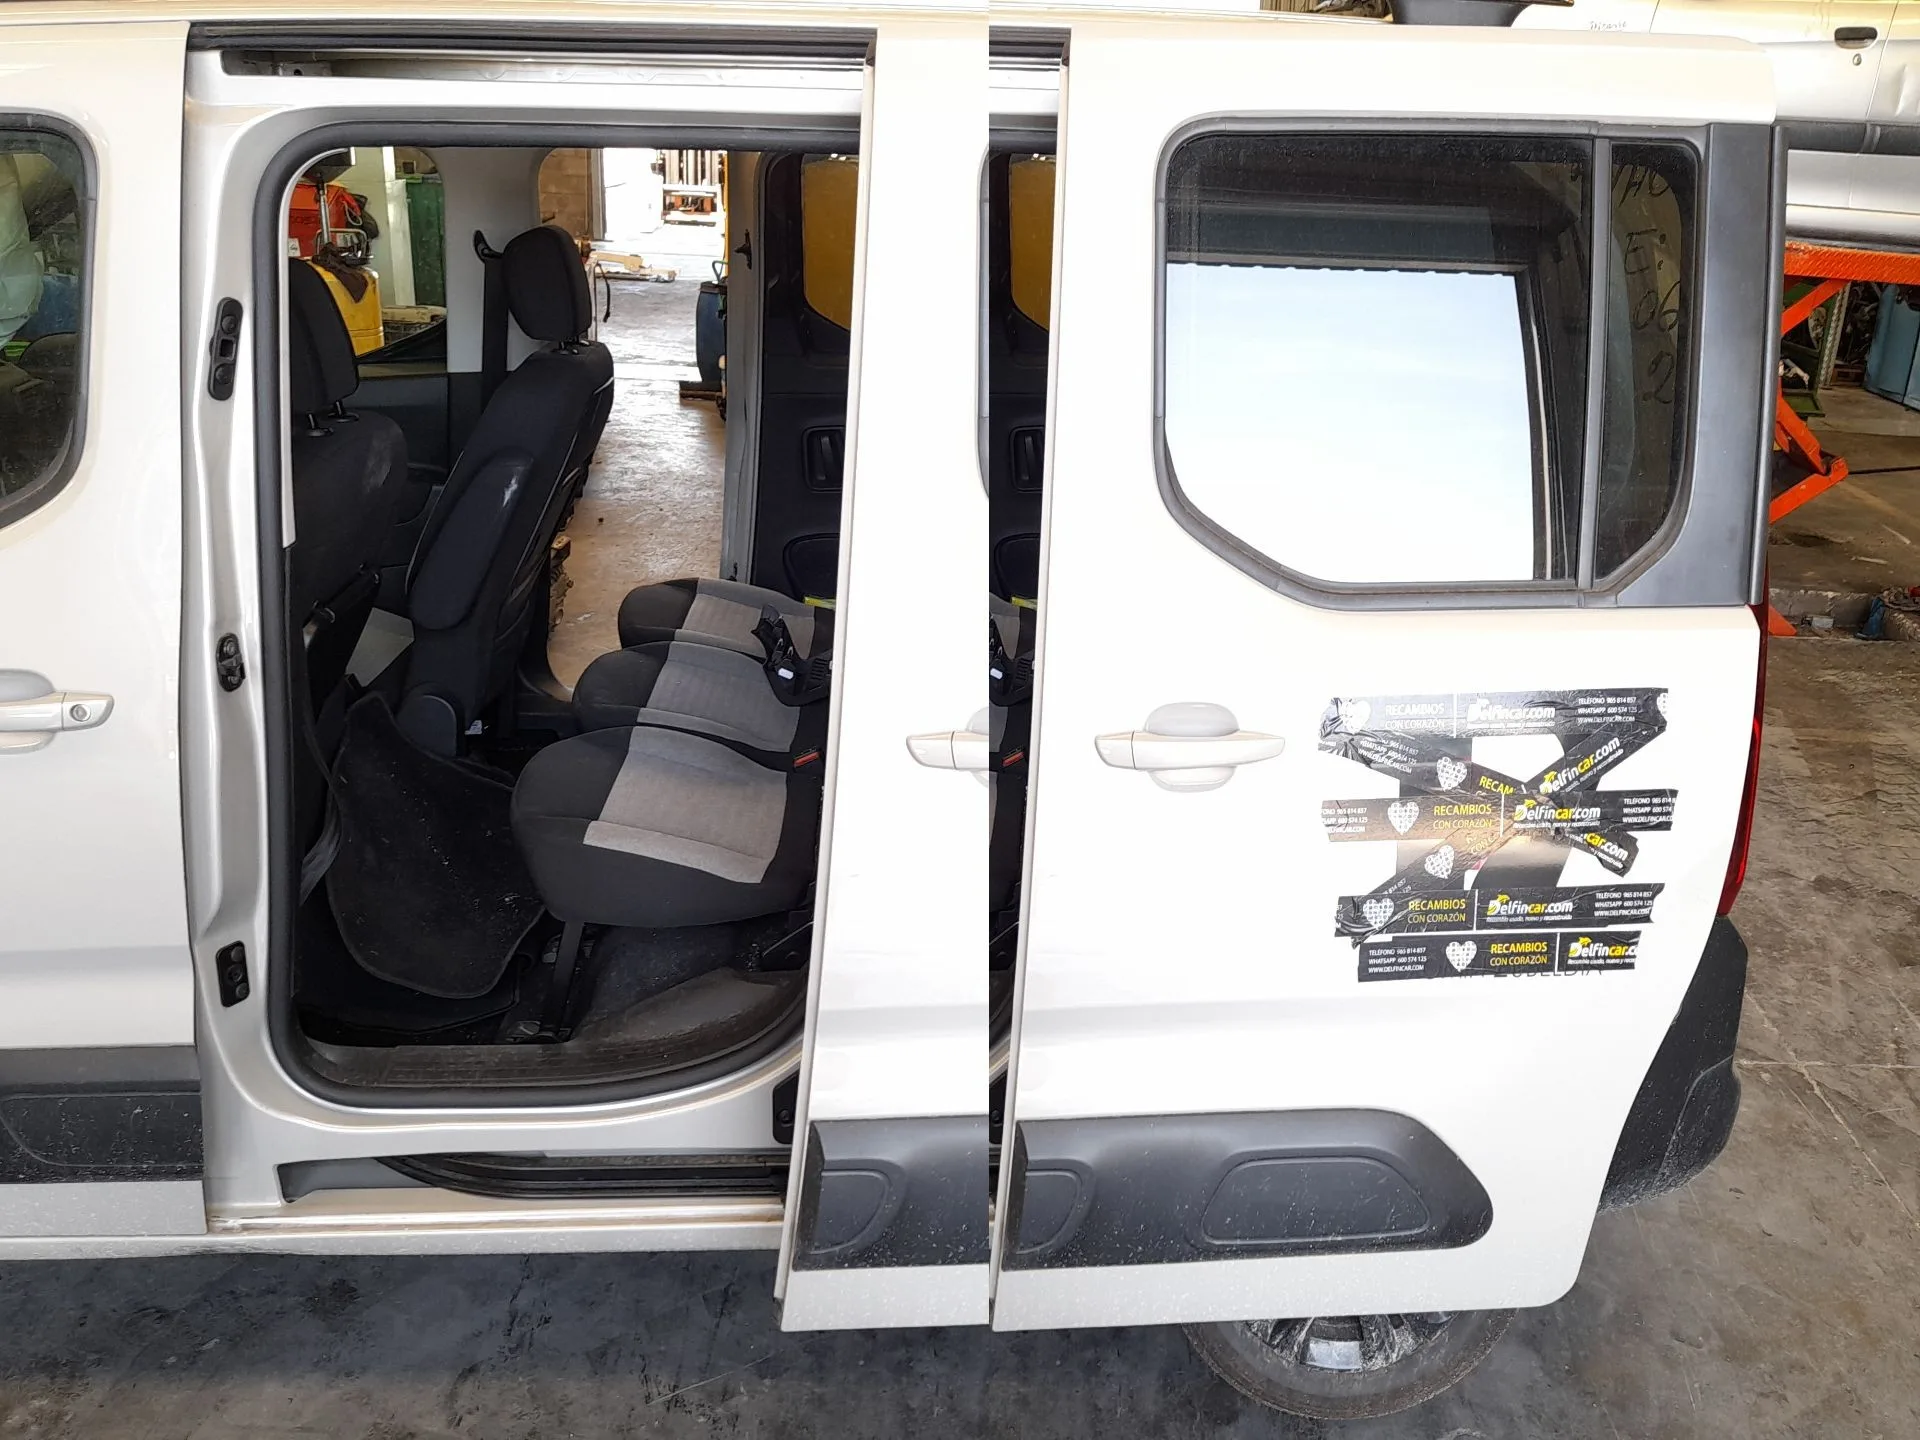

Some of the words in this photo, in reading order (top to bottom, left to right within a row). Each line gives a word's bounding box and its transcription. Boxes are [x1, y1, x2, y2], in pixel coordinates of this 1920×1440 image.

[1385, 703, 1445, 716] RECAMBIOS
[1479, 775, 1516, 795] RECAM
[1433, 803, 1492, 816] RECAMBIOS
[1513, 802, 1601, 821] Delfincar.com
[1433, 819, 1453, 830] CON
[1453, 817, 1492, 829] CORAZÓN
[1584, 832, 1629, 861] car.com
[1595, 891, 1622, 899] TELÉFONO
[1408, 898, 1466, 911] RECAMBIOS
[1486, 898, 1573, 916] Delfincar.com
[1407, 913, 1426, 924] CON
[1426, 911, 1466, 923] CORAZÓN
[1368, 948, 1396, 956] TELÉFONO
[1406, 947, 1417, 955] 814
[1490, 941, 1548, 954] RECAMBIOS
[1368, 957, 1396, 965] WHATSAPP
[1489, 956, 1508, 967] CON
[1508, 954, 1548, 966] CORAZÓN
[1367, 965, 1425, 974] WWW.DELFINCAR.COM
